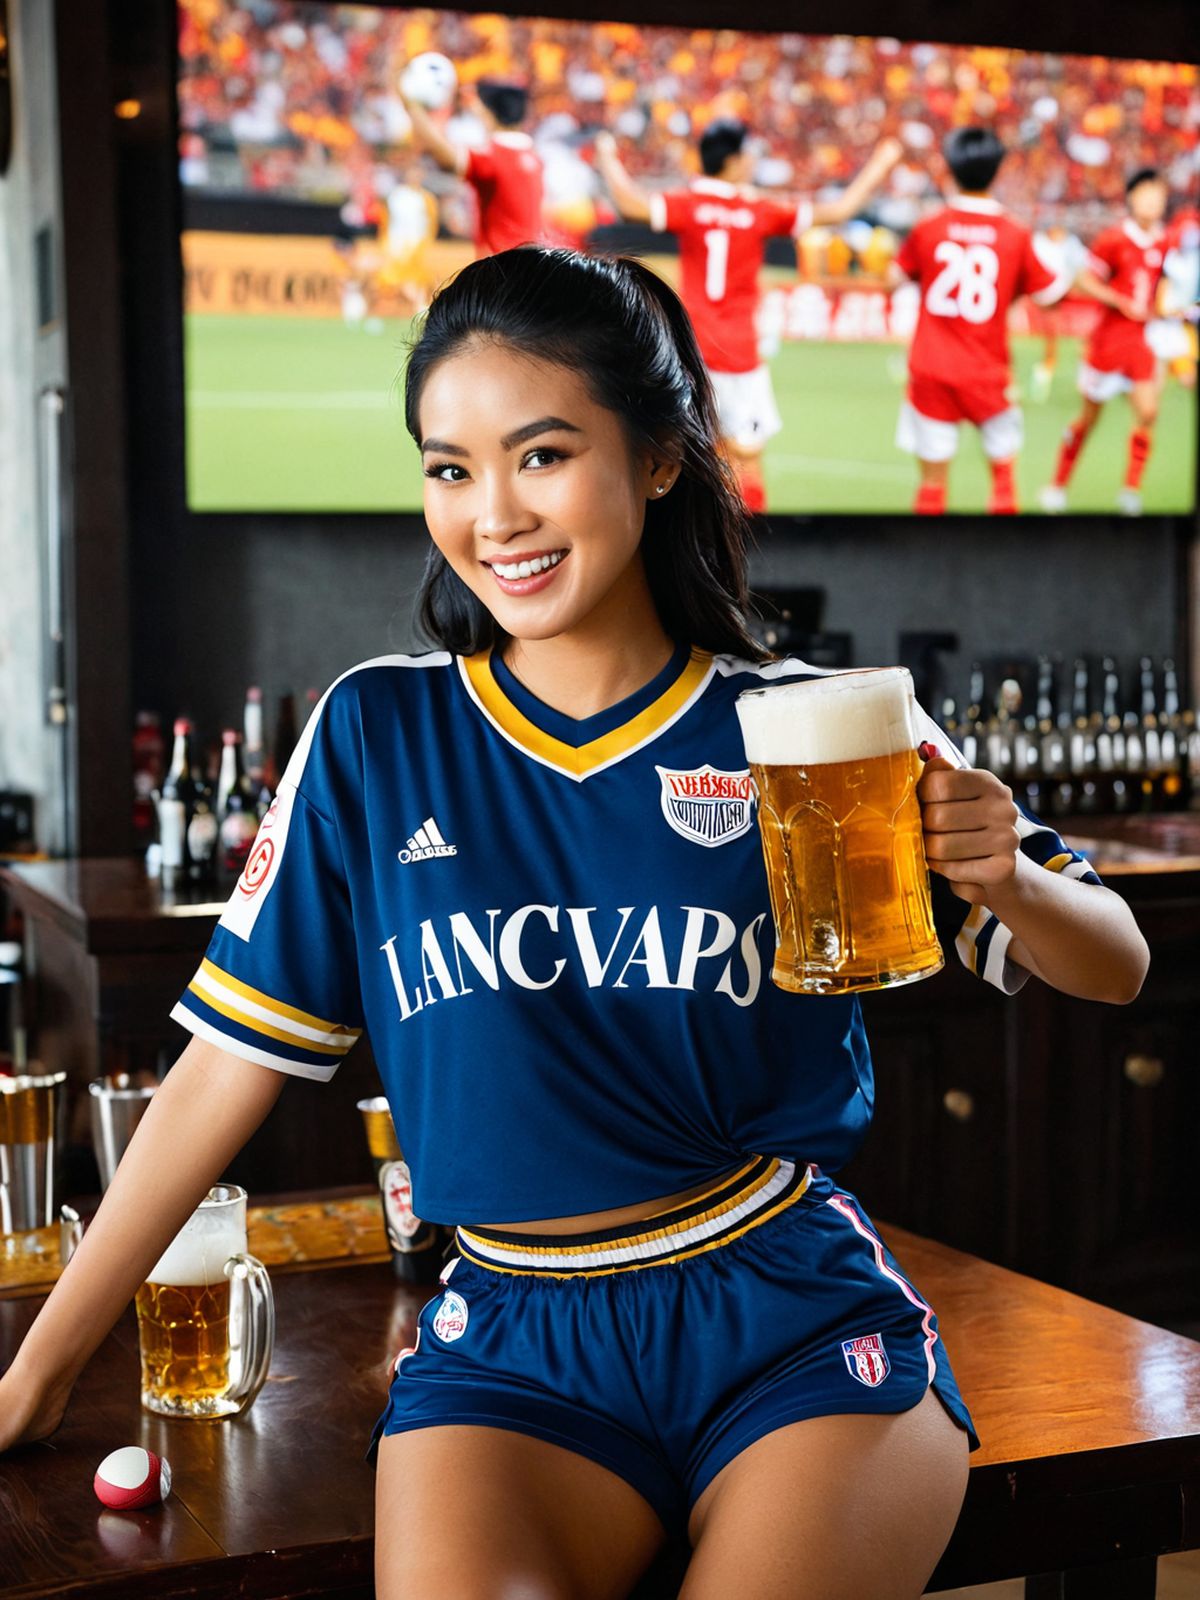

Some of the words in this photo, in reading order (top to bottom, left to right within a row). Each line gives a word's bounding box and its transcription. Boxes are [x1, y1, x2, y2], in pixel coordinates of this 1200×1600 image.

[704, 229, 729, 301] 1
[926, 241, 999, 324] 28
[379, 904, 767, 1022] LANCVAPS
